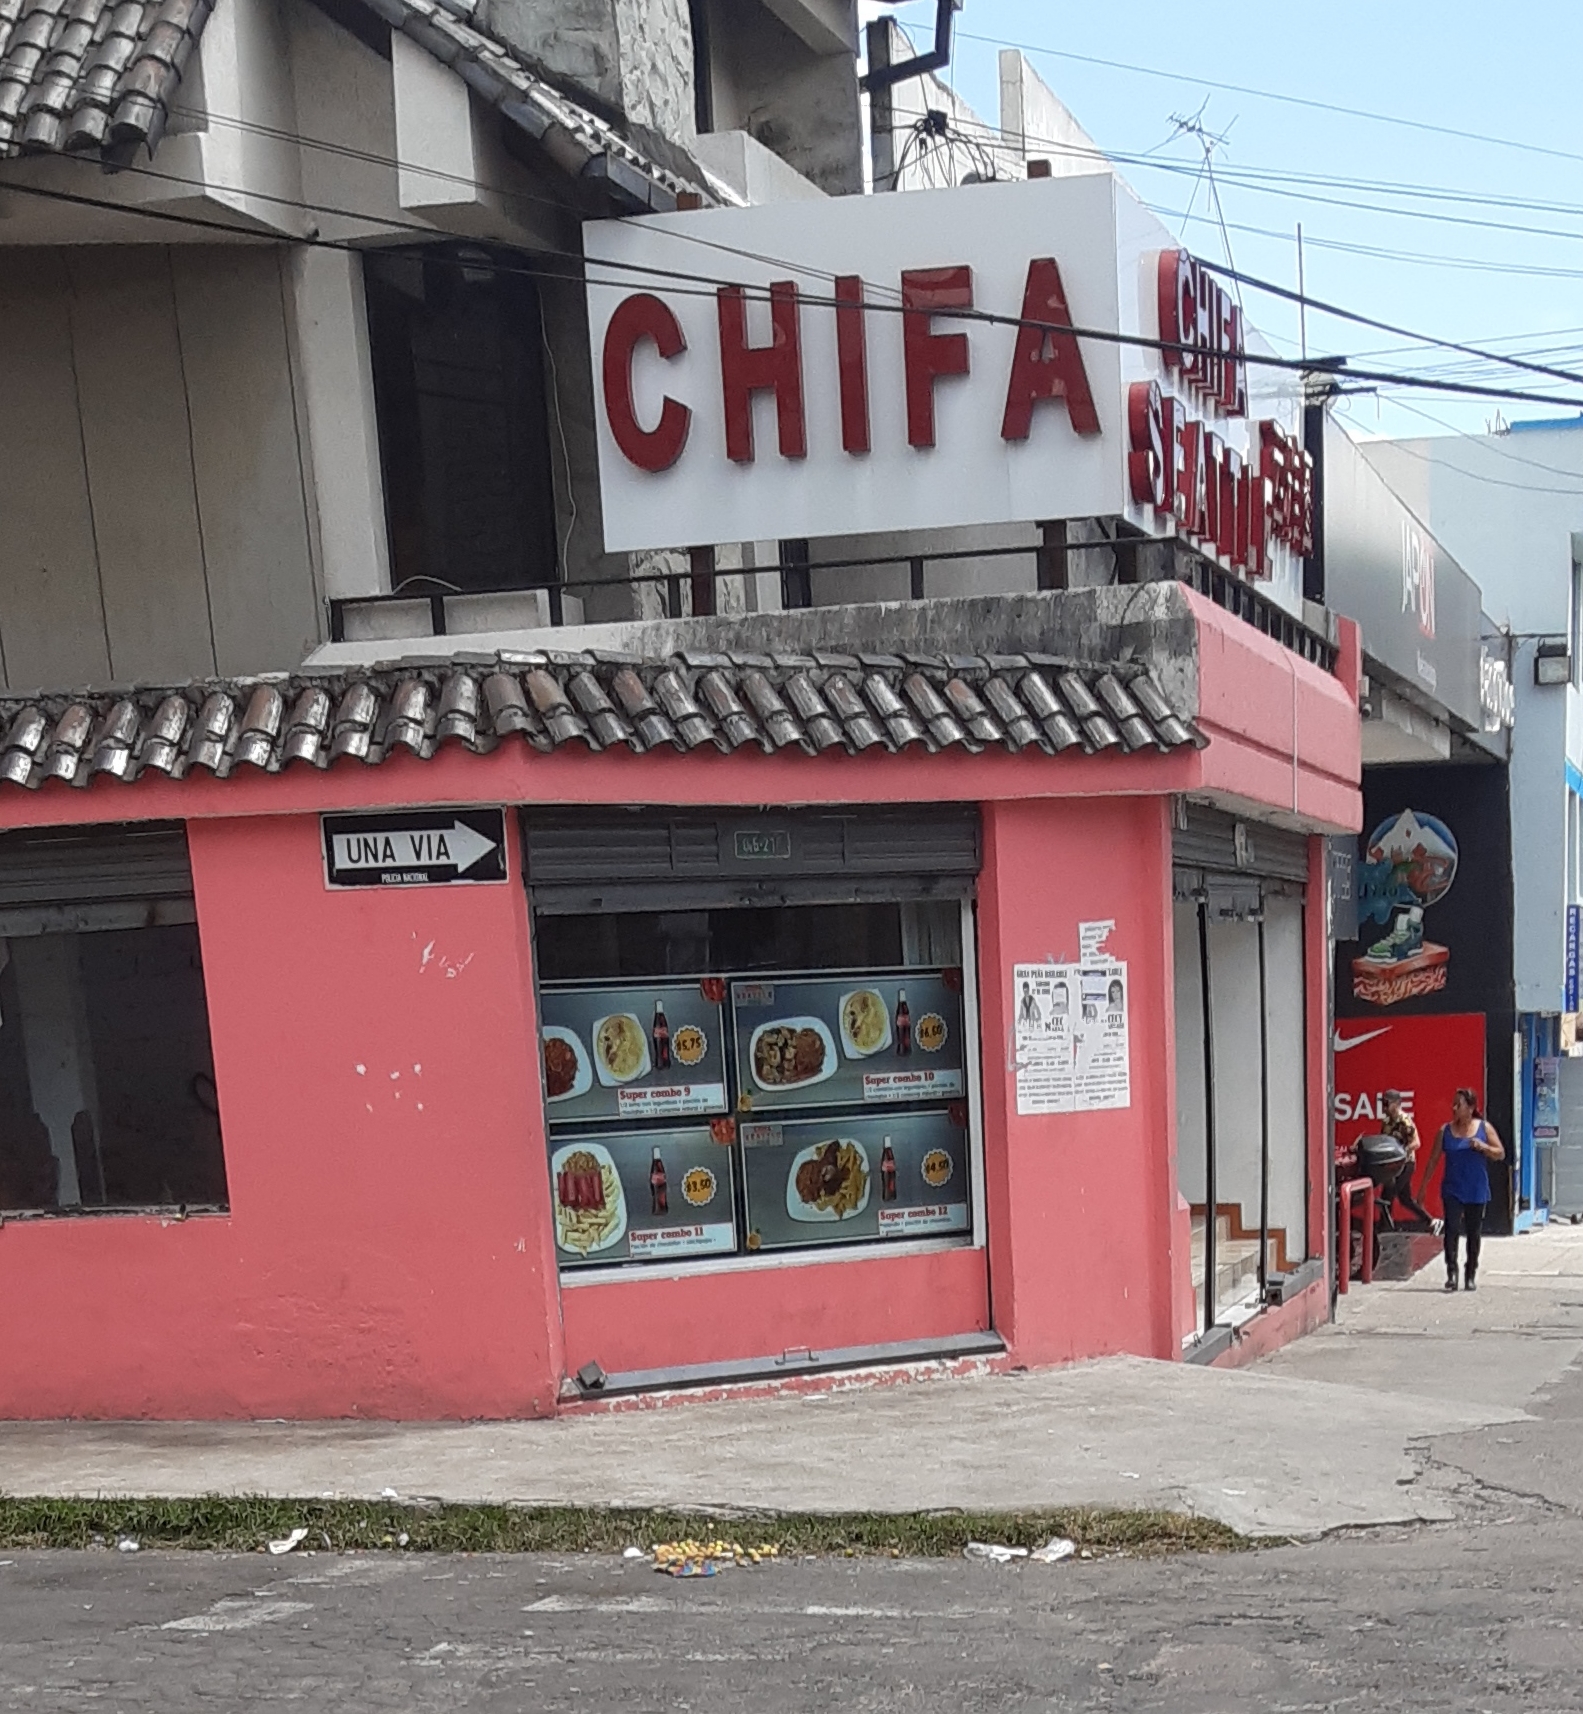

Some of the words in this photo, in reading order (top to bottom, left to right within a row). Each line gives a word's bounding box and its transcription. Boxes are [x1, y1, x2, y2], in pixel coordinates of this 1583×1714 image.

[1157, 247, 1248, 418] CHIFA
[602, 256, 1102, 474] CHIFA
[346, 836, 396, 864] UNA
[410, 833, 451, 862] VIA
[865, 1075, 890, 1086] Super
[893, 1073, 922, 1083] combo
[924, 1072, 935, 1082] 10
[620, 1090, 647, 1101] Super
[651, 1087, 682, 1098] combo
[684, 1086, 691, 1097] 9
[1334, 1091, 1414, 1120] SALE
[880, 1211, 905, 1221] Super
[907, 1207, 936, 1218] combo
[630, 1231, 658, 1243] Super
[661, 1228, 692, 1240] combo
[694, 1226, 704, 1237] 11
